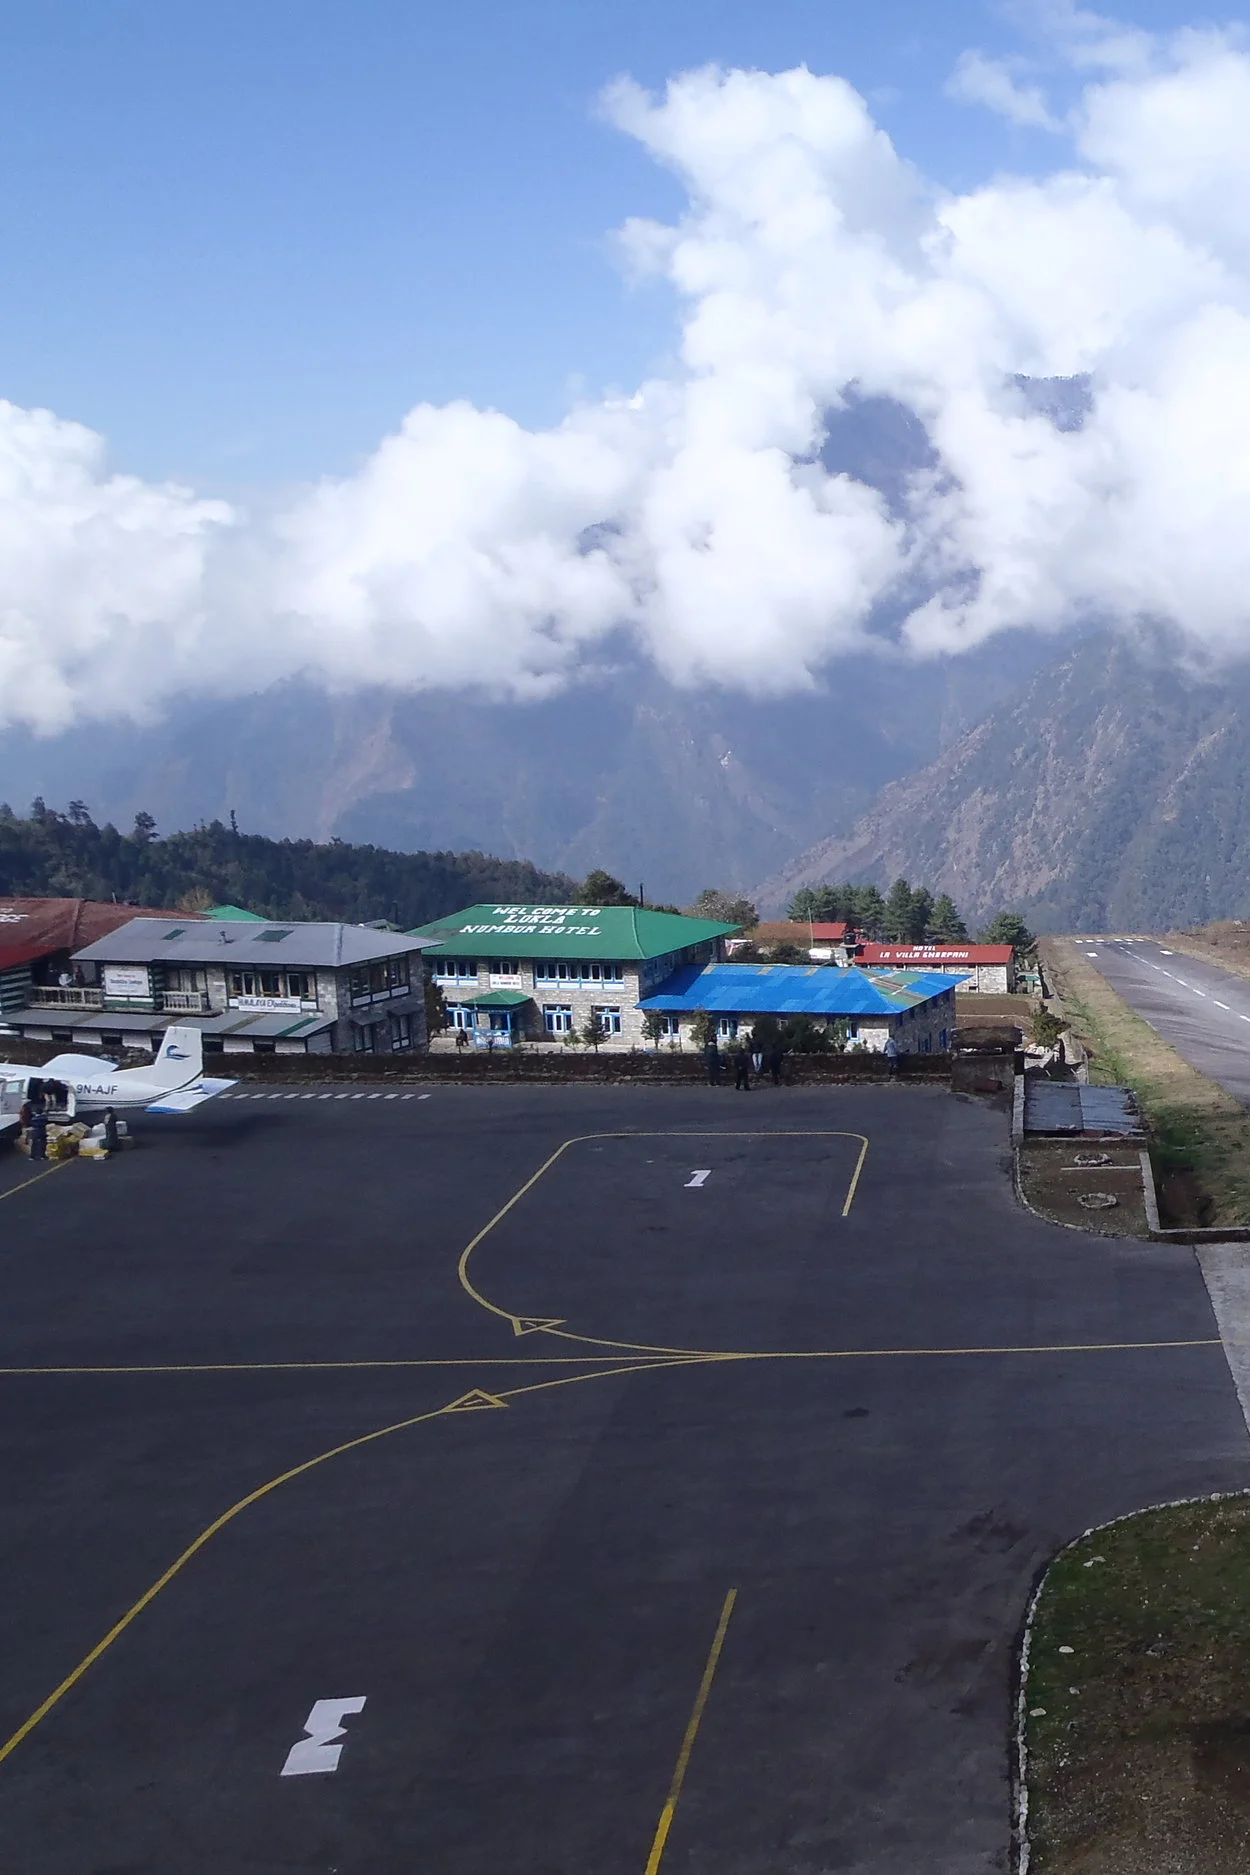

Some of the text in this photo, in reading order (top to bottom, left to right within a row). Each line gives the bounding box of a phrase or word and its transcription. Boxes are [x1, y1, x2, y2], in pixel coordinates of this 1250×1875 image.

[538, 926, 602, 935] HOTEL
[77, 1084, 118, 1095] 9N-AJF
[683, 1169, 712, 1187] 1
